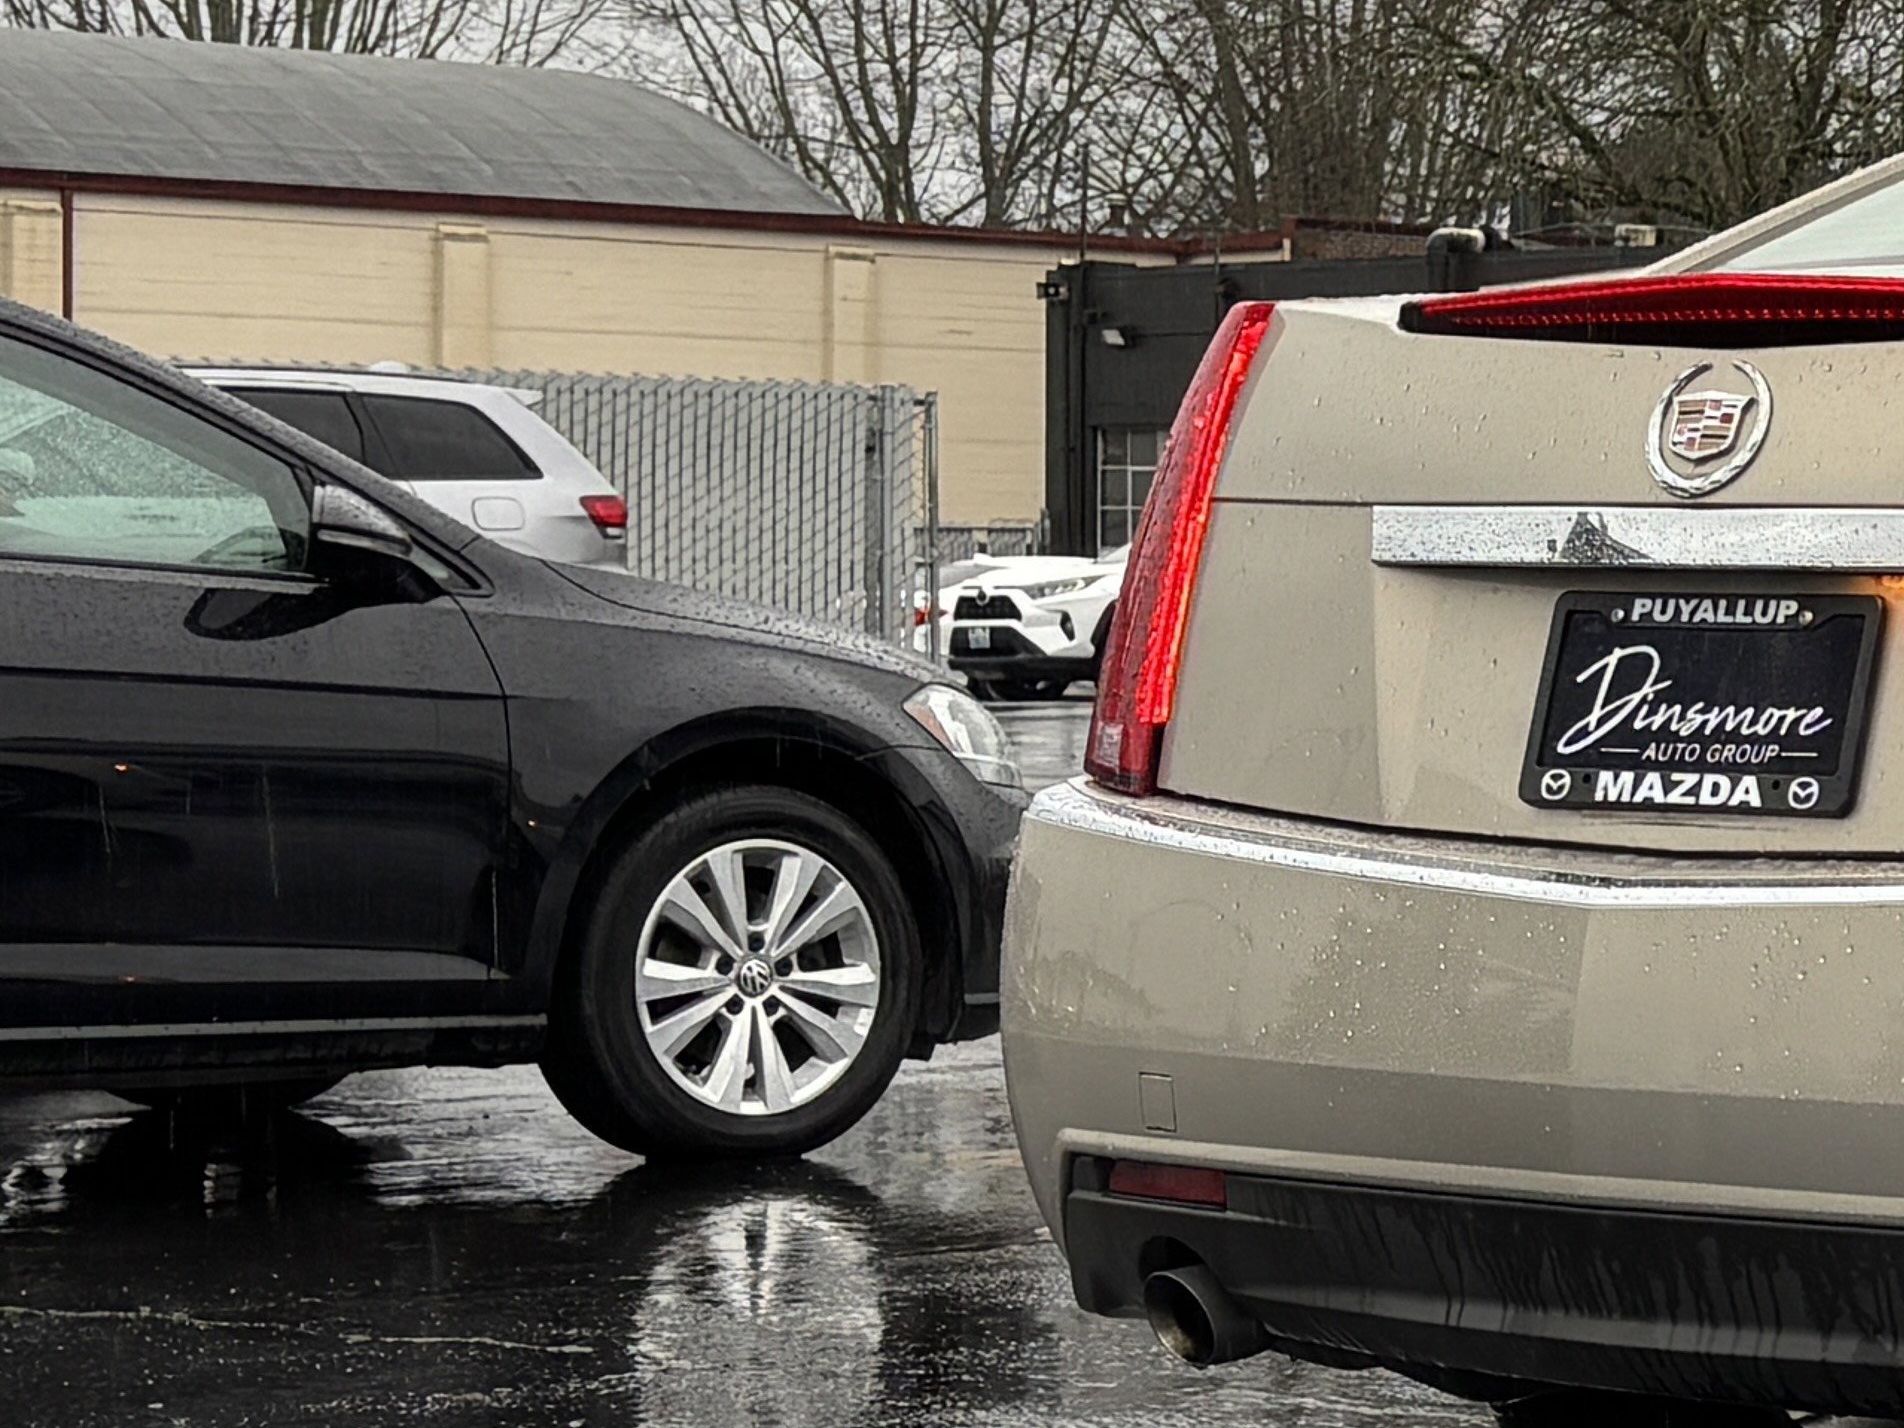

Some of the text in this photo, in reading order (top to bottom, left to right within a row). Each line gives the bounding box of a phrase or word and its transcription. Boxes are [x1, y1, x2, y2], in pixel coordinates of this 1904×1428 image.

[1631, 598, 1799, 624] PUYALLUP
[1556, 645, 1833, 755] Dinsmore
[1641, 742, 1780, 764] AUTO GROUP
[1594, 771, 1762, 808] MAZDA
